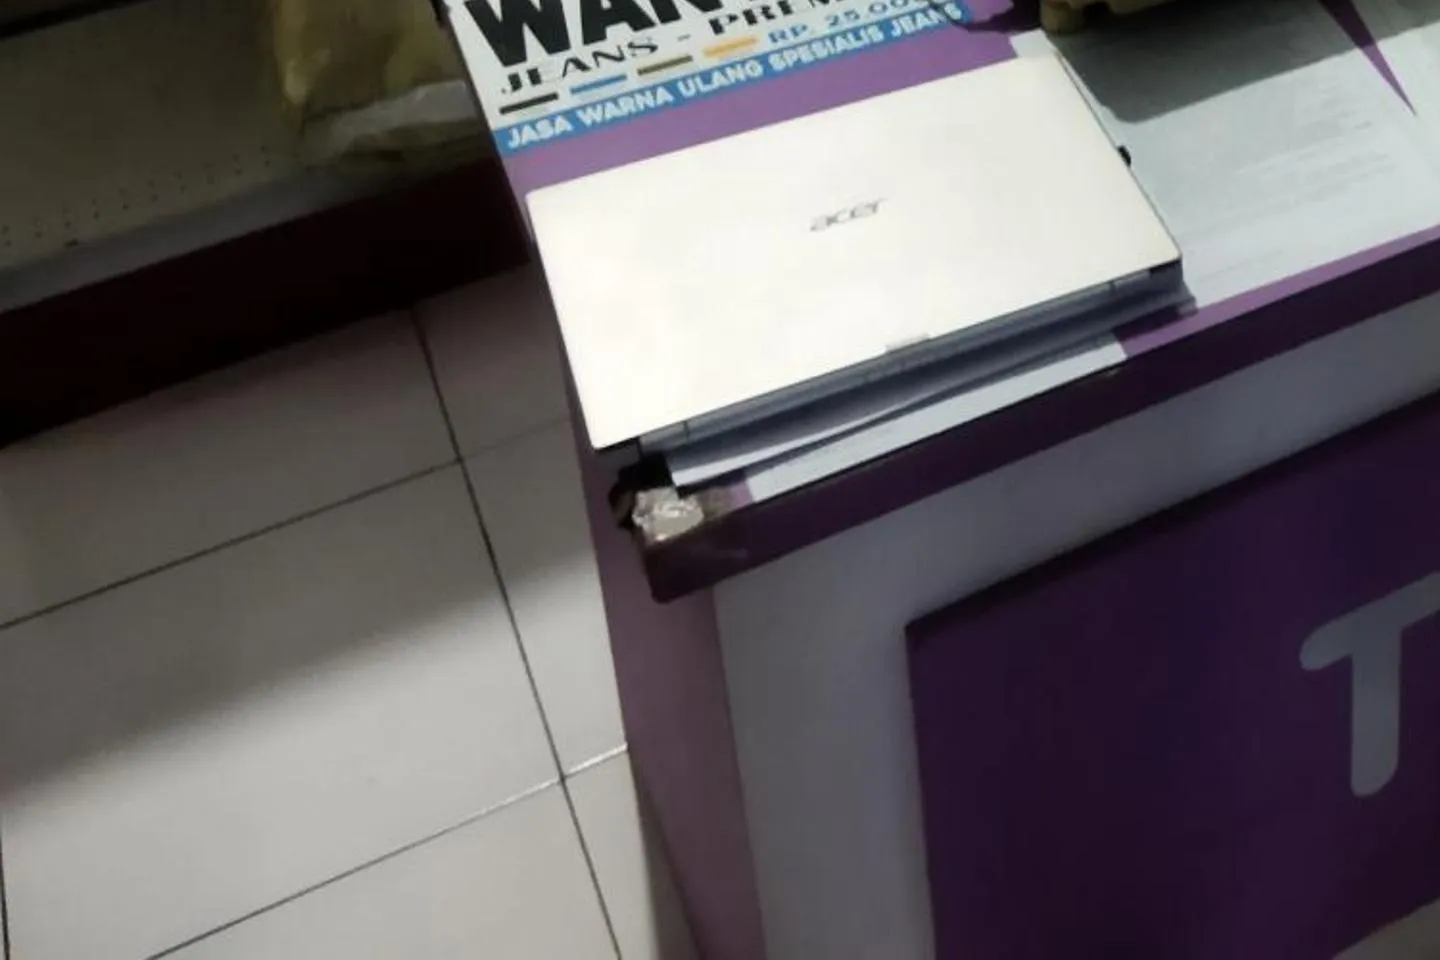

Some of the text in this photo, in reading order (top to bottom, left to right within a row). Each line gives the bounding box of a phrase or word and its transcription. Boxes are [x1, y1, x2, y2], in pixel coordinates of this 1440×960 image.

[501, 37, 659, 94] JEANS
[507, 112, 574, 150] JASA
[575, 86, 675, 127] WARNA
[677, 59, 764, 98] ULANG
[766, 25, 885, 72] SPESIALIS
[809, 197, 889, 233] acer
